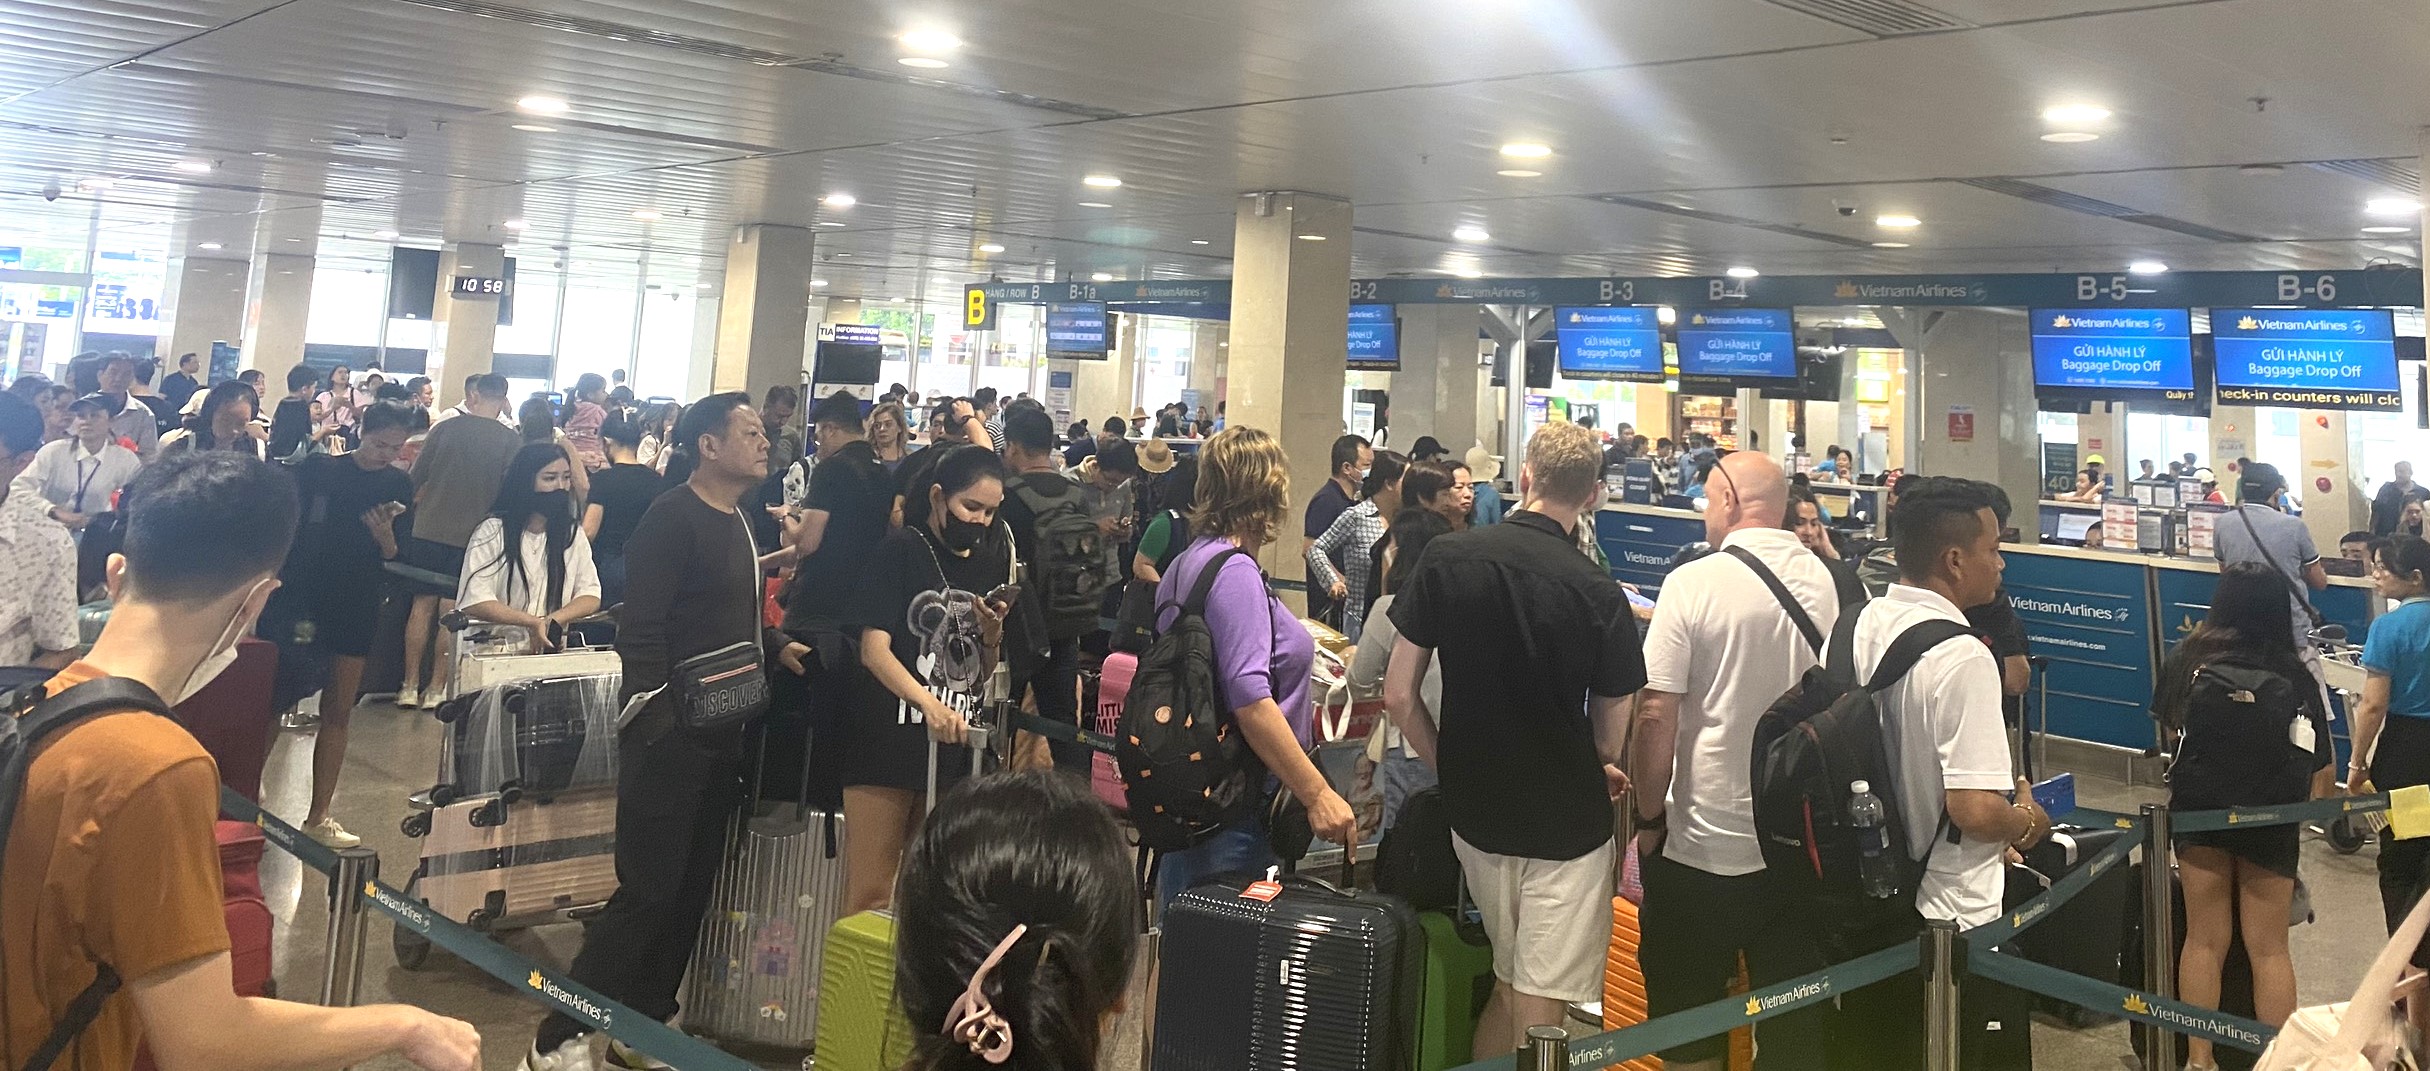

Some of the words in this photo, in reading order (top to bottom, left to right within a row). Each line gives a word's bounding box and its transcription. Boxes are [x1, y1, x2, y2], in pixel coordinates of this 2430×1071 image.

[462, 279, 477, 292] 10
[483, 280, 503, 293] 58
[1010, 288, 1027, 298] ROW
[1031, 285, 1040, 300] B
[1070, 284, 1096, 300] B-1a
[1350, 282, 1376, 300] B-2
[1600, 281, 1634, 301] B-3
[1709, 280, 1746, 300] B-4
[2077, 276, 2127, 301] B-5
[2278, 275, 2336, 301] B-6
[967, 289, 986, 325] B
[820, 327, 834, 335] TIA
[836, 326, 879, 335] INFORMATION
[1577, 347, 1609, 359] Baggage
[1610, 348, 1628, 359] Drop
[1630, 349, 1642, 358] Off
[1699, 351, 1735, 363] Baggage
[1736, 351, 1758, 363] Drop
[1759, 352, 1773, 361] Off
[2097, 344, 2131, 358] HÀNH
[2133, 344, 2146, 358] LÝ
[2288, 348, 2326, 362] HÀNH
[2330, 348, 2344, 363] LÝ
[2062, 359, 2110, 373] Baggage
[2113, 360, 2141, 373] Drop
[2143, 361, 2162, 371] Off
[2249, 363, 2303, 379] Baggage
[2306, 364, 2338, 379] Drop
[2341, 365, 2362, 377] Off
[2273, 391, 2342, 404] counters
[2346, 393, 2373, 405] will
[2048, 476, 2070, 490] 40
[1569, 1047, 1603, 1067] Airlines
